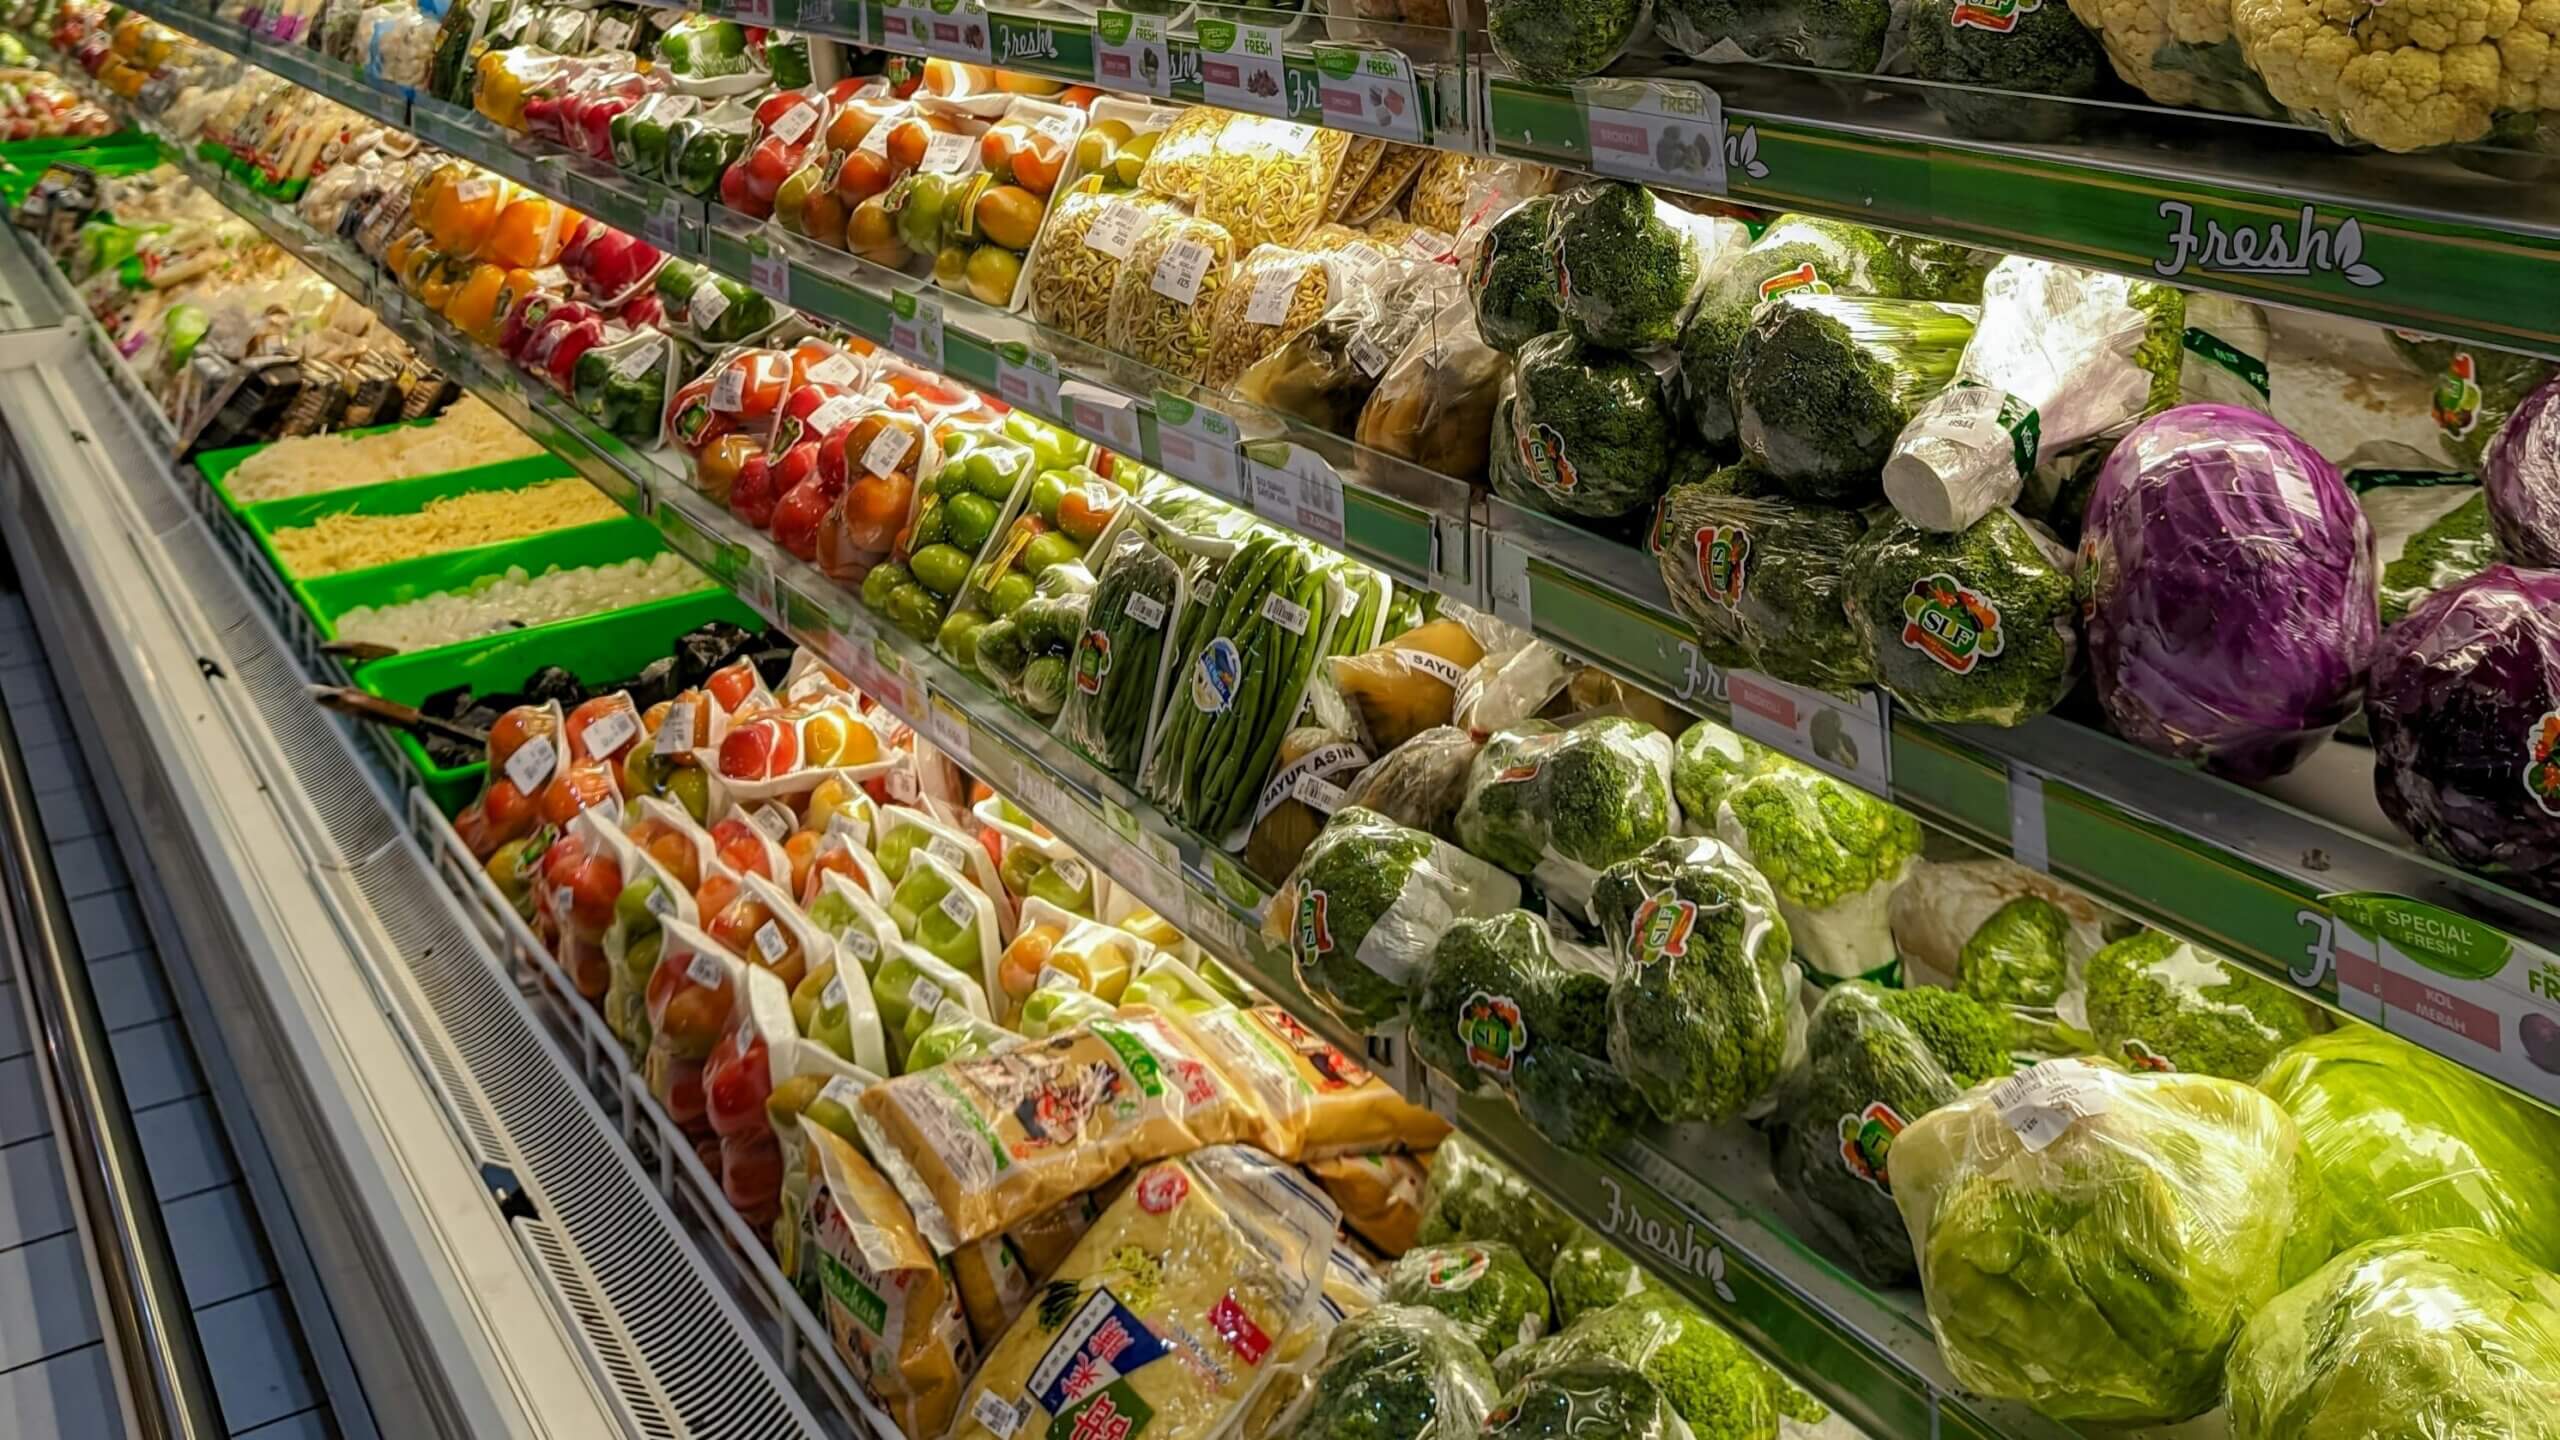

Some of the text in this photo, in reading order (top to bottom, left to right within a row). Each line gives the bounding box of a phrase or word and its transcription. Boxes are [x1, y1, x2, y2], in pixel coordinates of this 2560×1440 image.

[999, 20, 1053, 64] Fresh
[1135, 27, 1158, 43] FRESH
[1244, 38, 1273, 56] FRESH
[1366, 60, 1398, 77] FRESH
[1660, 95, 1705, 116] FRESH
[2154, 201, 2333, 276] Fresh
[1921, 609, 1975, 648] SLF
[1264, 747, 1356, 807] SAYUR ASIN
[1650, 907, 1674, 947] SLF
[2387, 909, 2474, 946] SPECIAL
[2405, 931, 2458, 957] FRESH
[2426, 987, 2454, 1011] KOL
[2416, 1003, 2467, 1035] MERAH
[1598, 1176, 1706, 1277] Fresh
